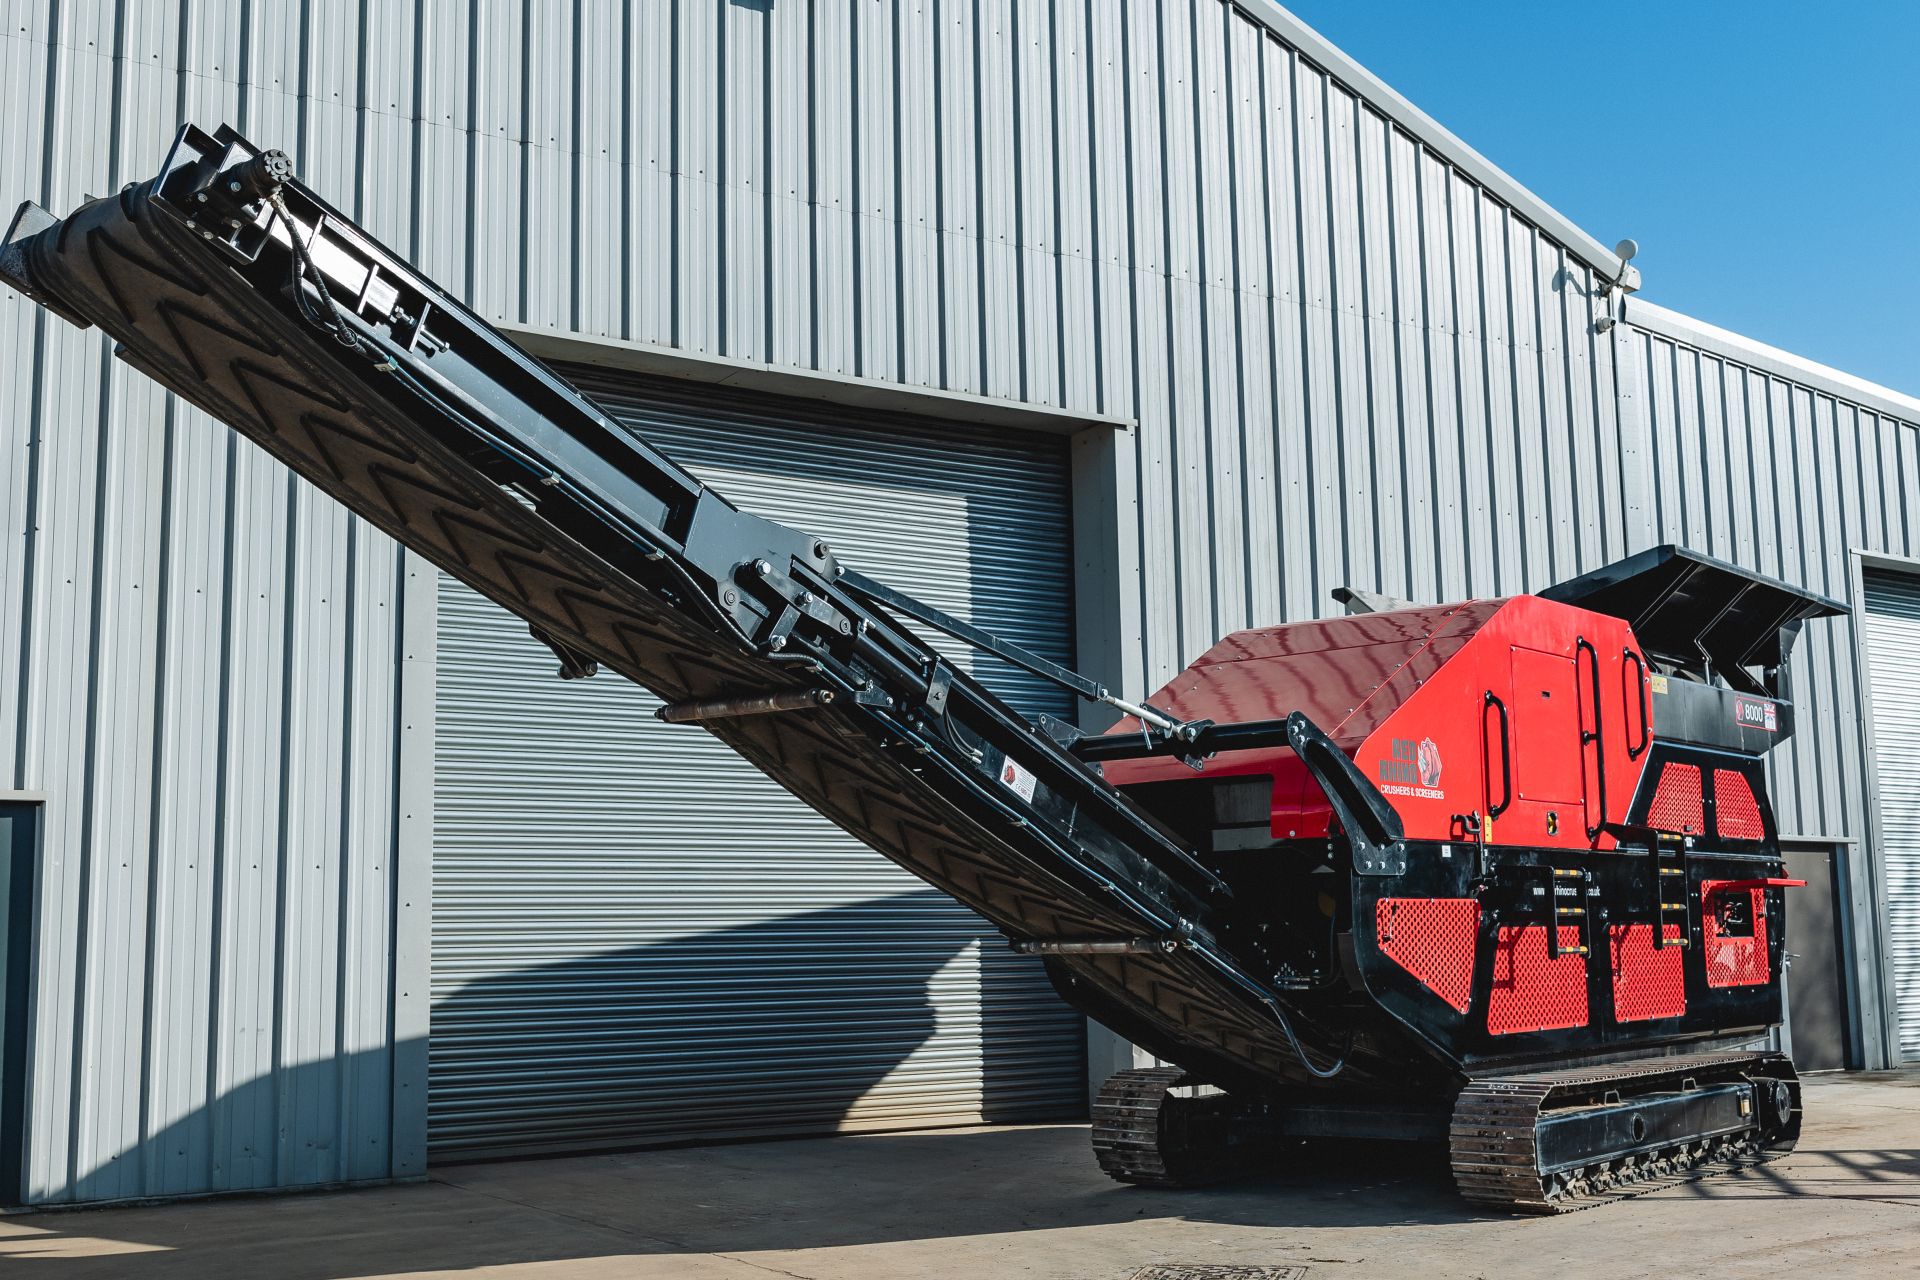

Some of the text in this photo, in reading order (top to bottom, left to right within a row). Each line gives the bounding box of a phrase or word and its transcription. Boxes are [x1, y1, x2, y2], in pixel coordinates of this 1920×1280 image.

[1745, 704, 1763, 722] 8000
[1392, 738, 1416, 761] RED
[1380, 760, 1418, 784] RHINO
[1381, 784, 1444, 799] CRUSHERS & SCREENERS
